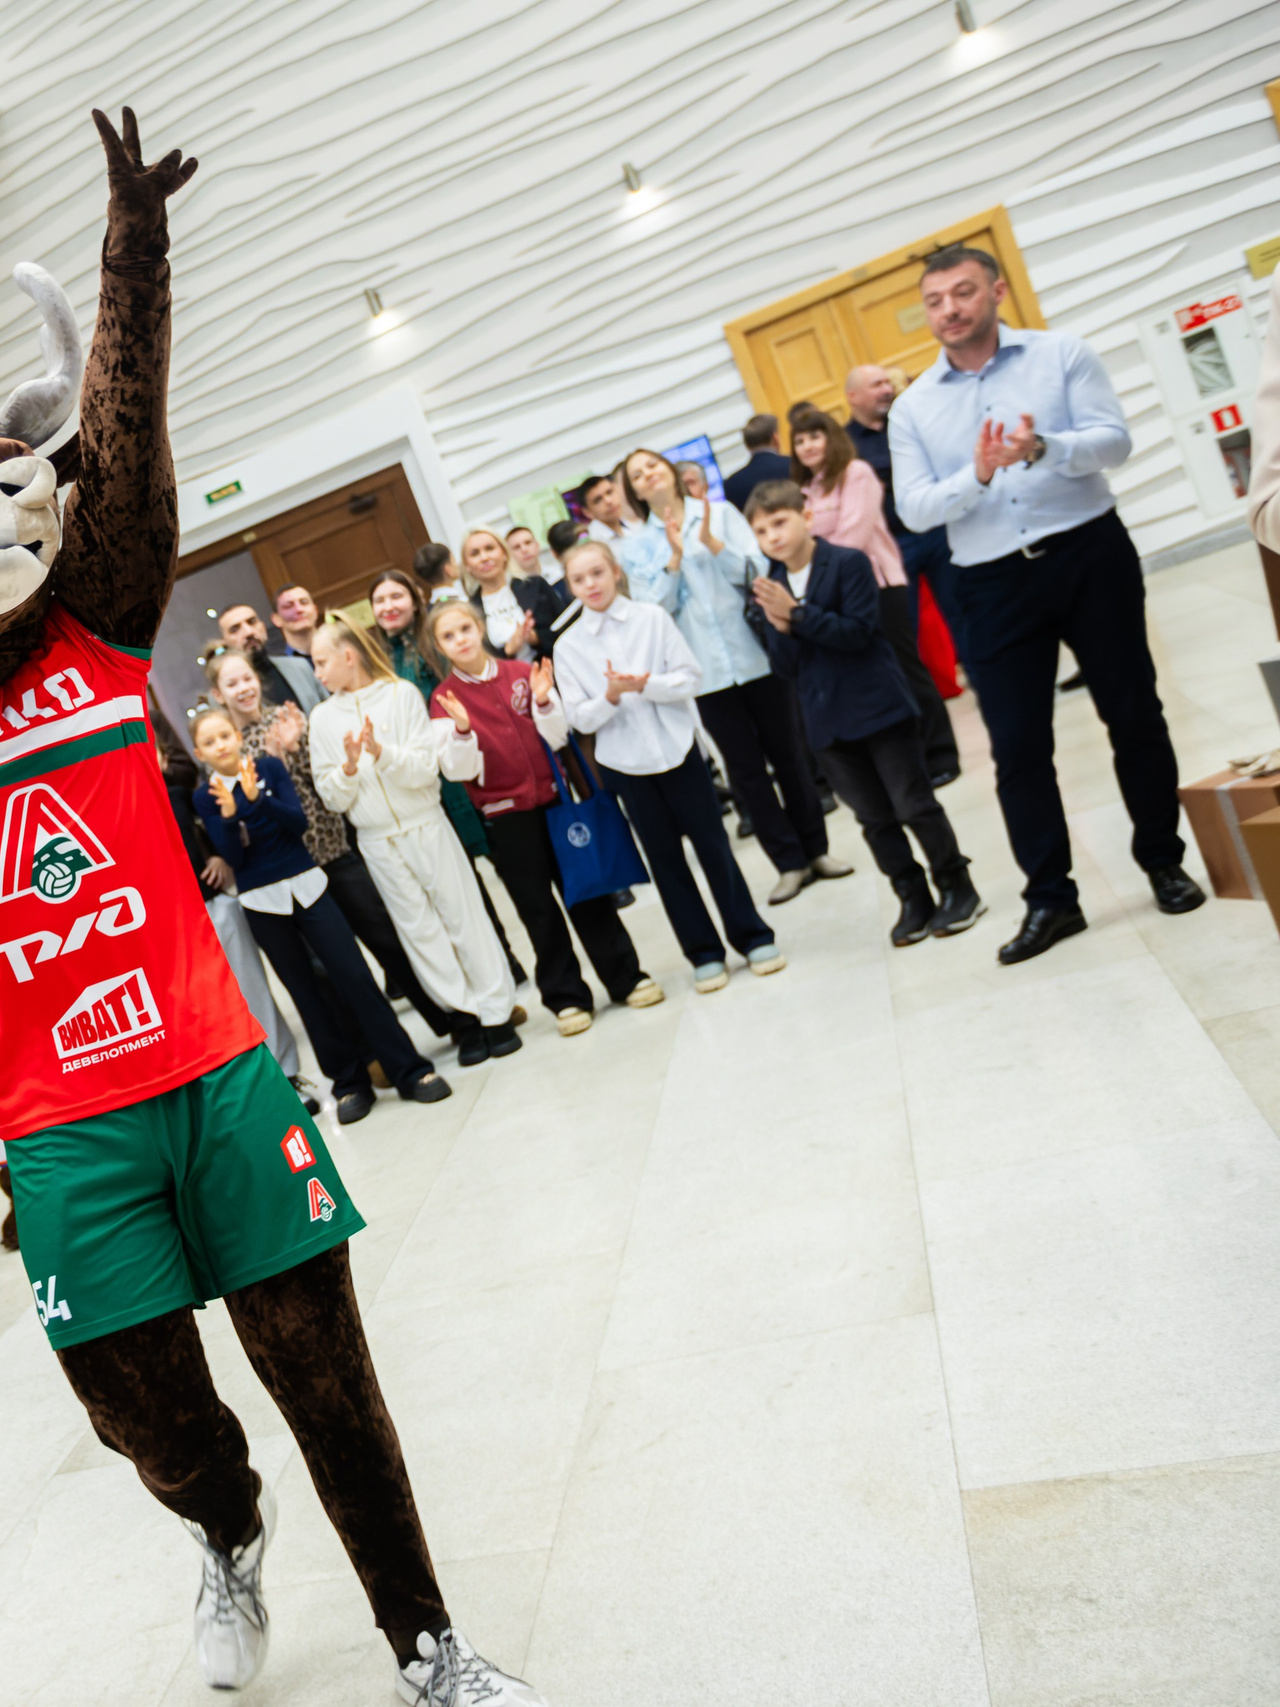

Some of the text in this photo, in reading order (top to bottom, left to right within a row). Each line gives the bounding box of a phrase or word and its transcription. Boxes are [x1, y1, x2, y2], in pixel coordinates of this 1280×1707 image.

[57, 973, 152, 1053] ВИВАТ!
[62, 1030, 166, 1075] ДЕВЕЛОПМЕНТ
[32, 1274, 73, 1327] 54
